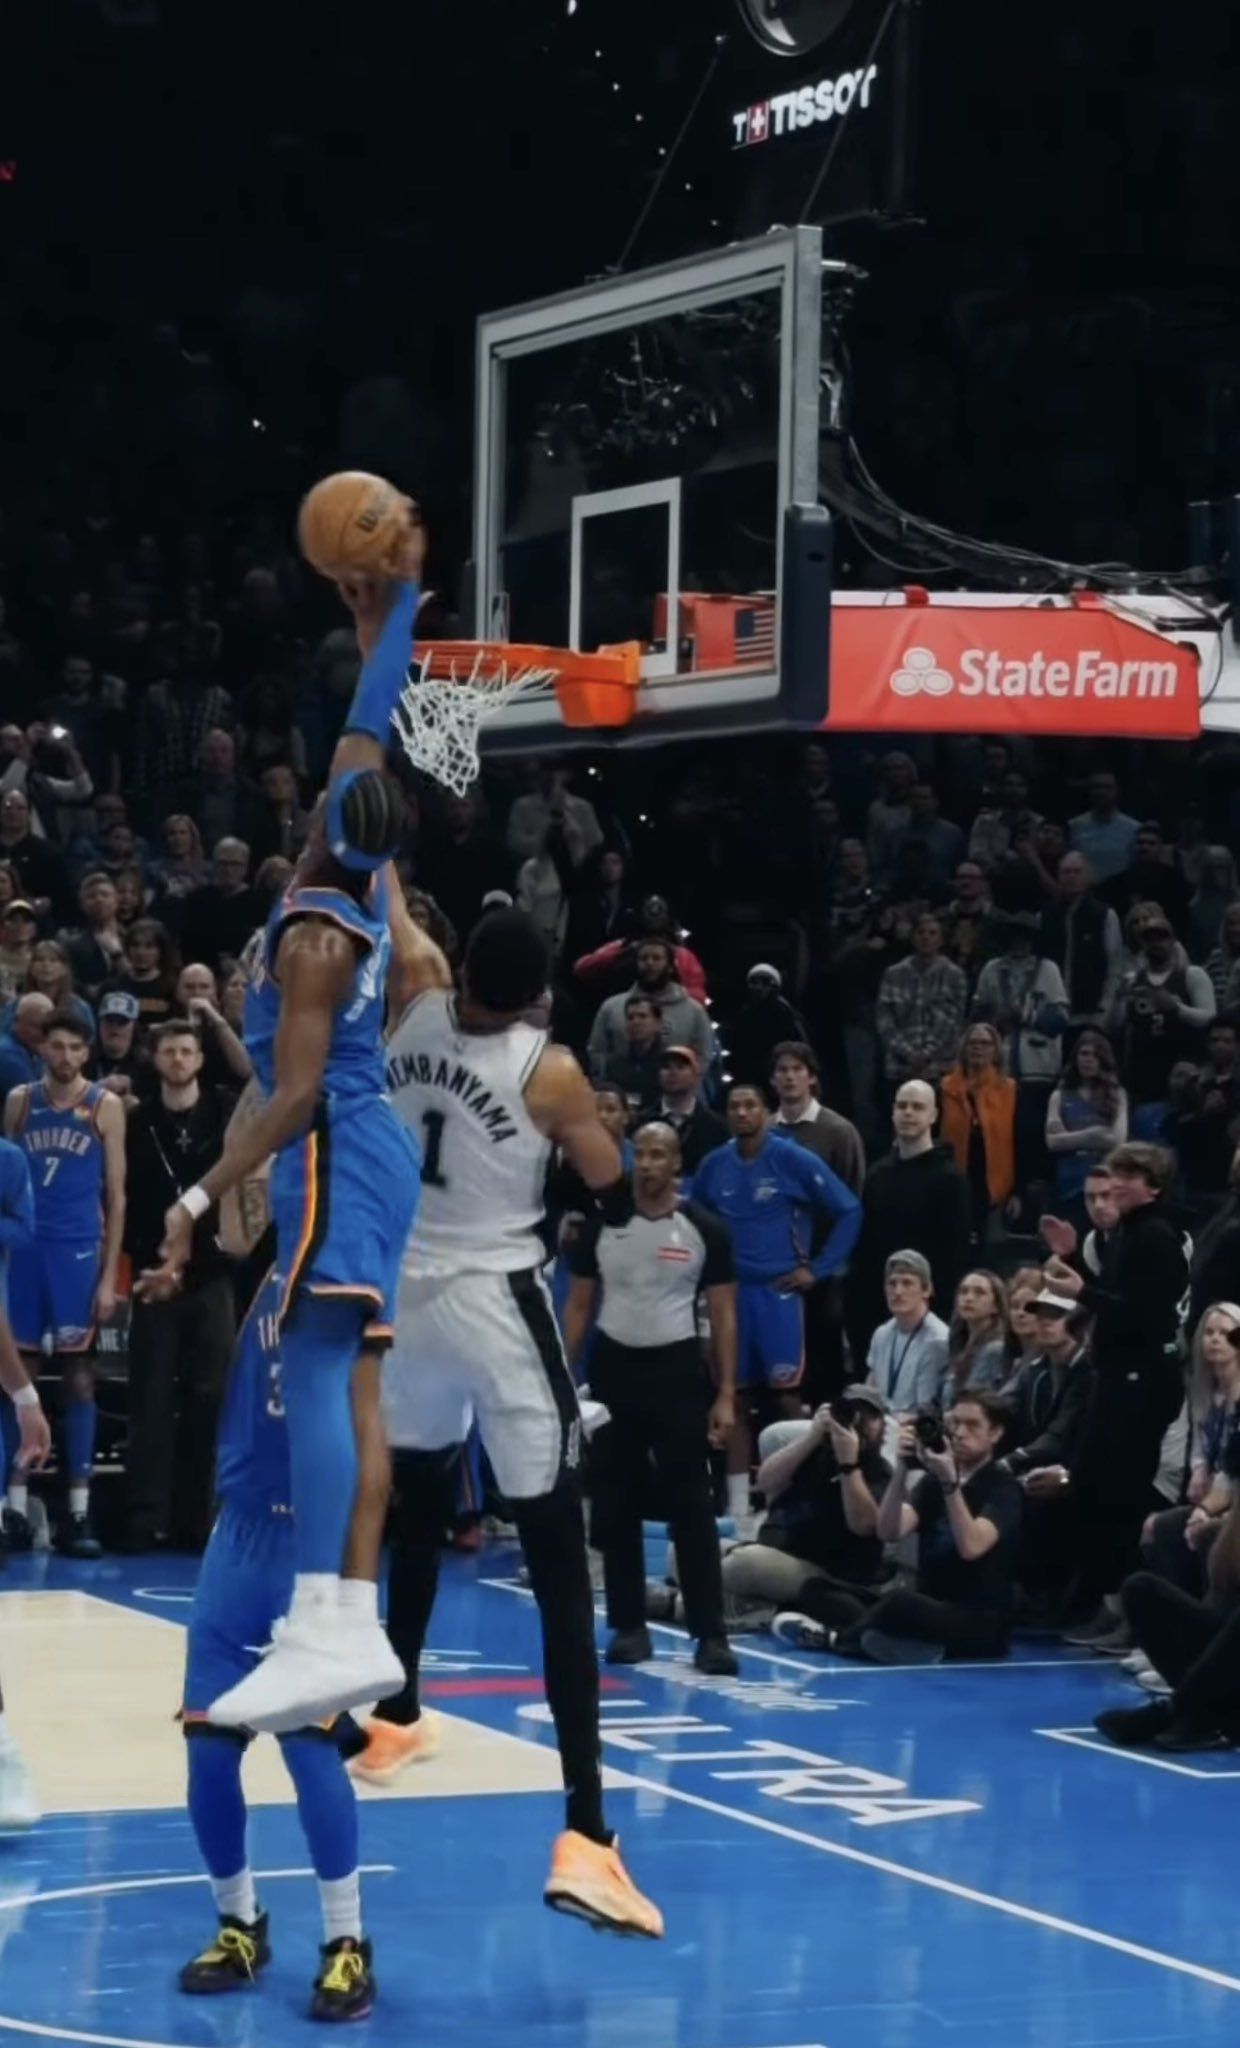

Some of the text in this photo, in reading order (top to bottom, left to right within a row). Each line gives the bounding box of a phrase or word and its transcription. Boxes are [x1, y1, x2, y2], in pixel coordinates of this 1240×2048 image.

[770, 63, 877, 136] TISSOT
[384, 1052, 519, 1145] EMBANYAMA
[25, 1126, 92, 1157] THUNDER
[42, 1156, 60, 1187] 7
[419, 1107, 448, 1189] 1
[516, 1700, 982, 1826] ULTRA
